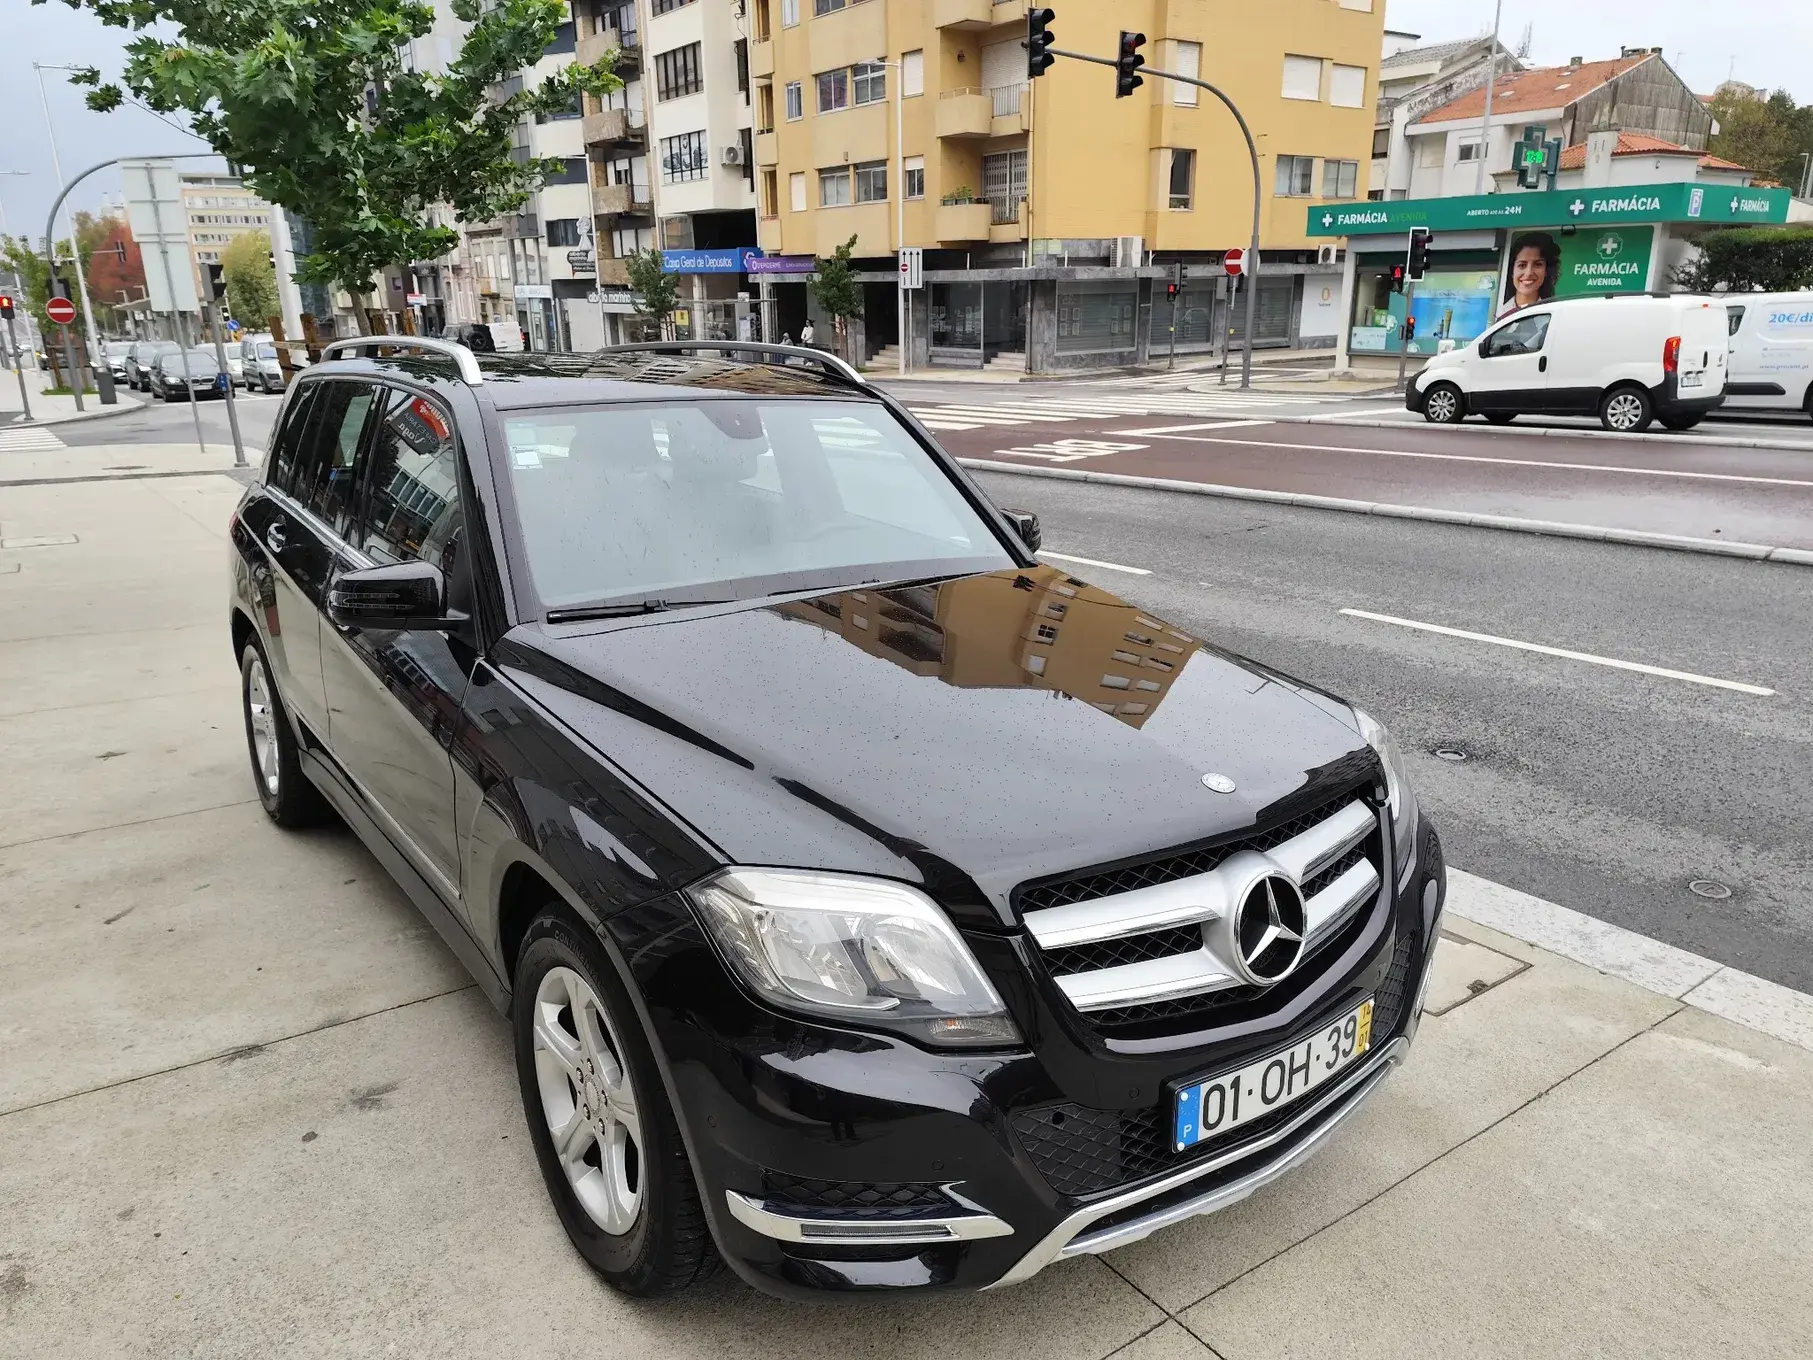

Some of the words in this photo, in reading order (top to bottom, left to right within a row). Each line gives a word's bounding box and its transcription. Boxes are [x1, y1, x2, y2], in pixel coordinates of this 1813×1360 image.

[1504, 205, 1522, 215] 24H
[1591, 194, 1661, 213] FARMÁCIA
[1739, 197, 1770, 213] FARMÁCIA
[1337, 210, 1388, 225] FARMÁCIA
[1389, 211, 1428, 223] AVENIDA
[680, 255, 696, 268] Geral
[697, 256, 704, 268] de
[1574, 261, 1639, 276] FARMÁCIA
[1586, 277, 1622, 286] AVENIDA
[1183, 1124, 1192, 1139] P
